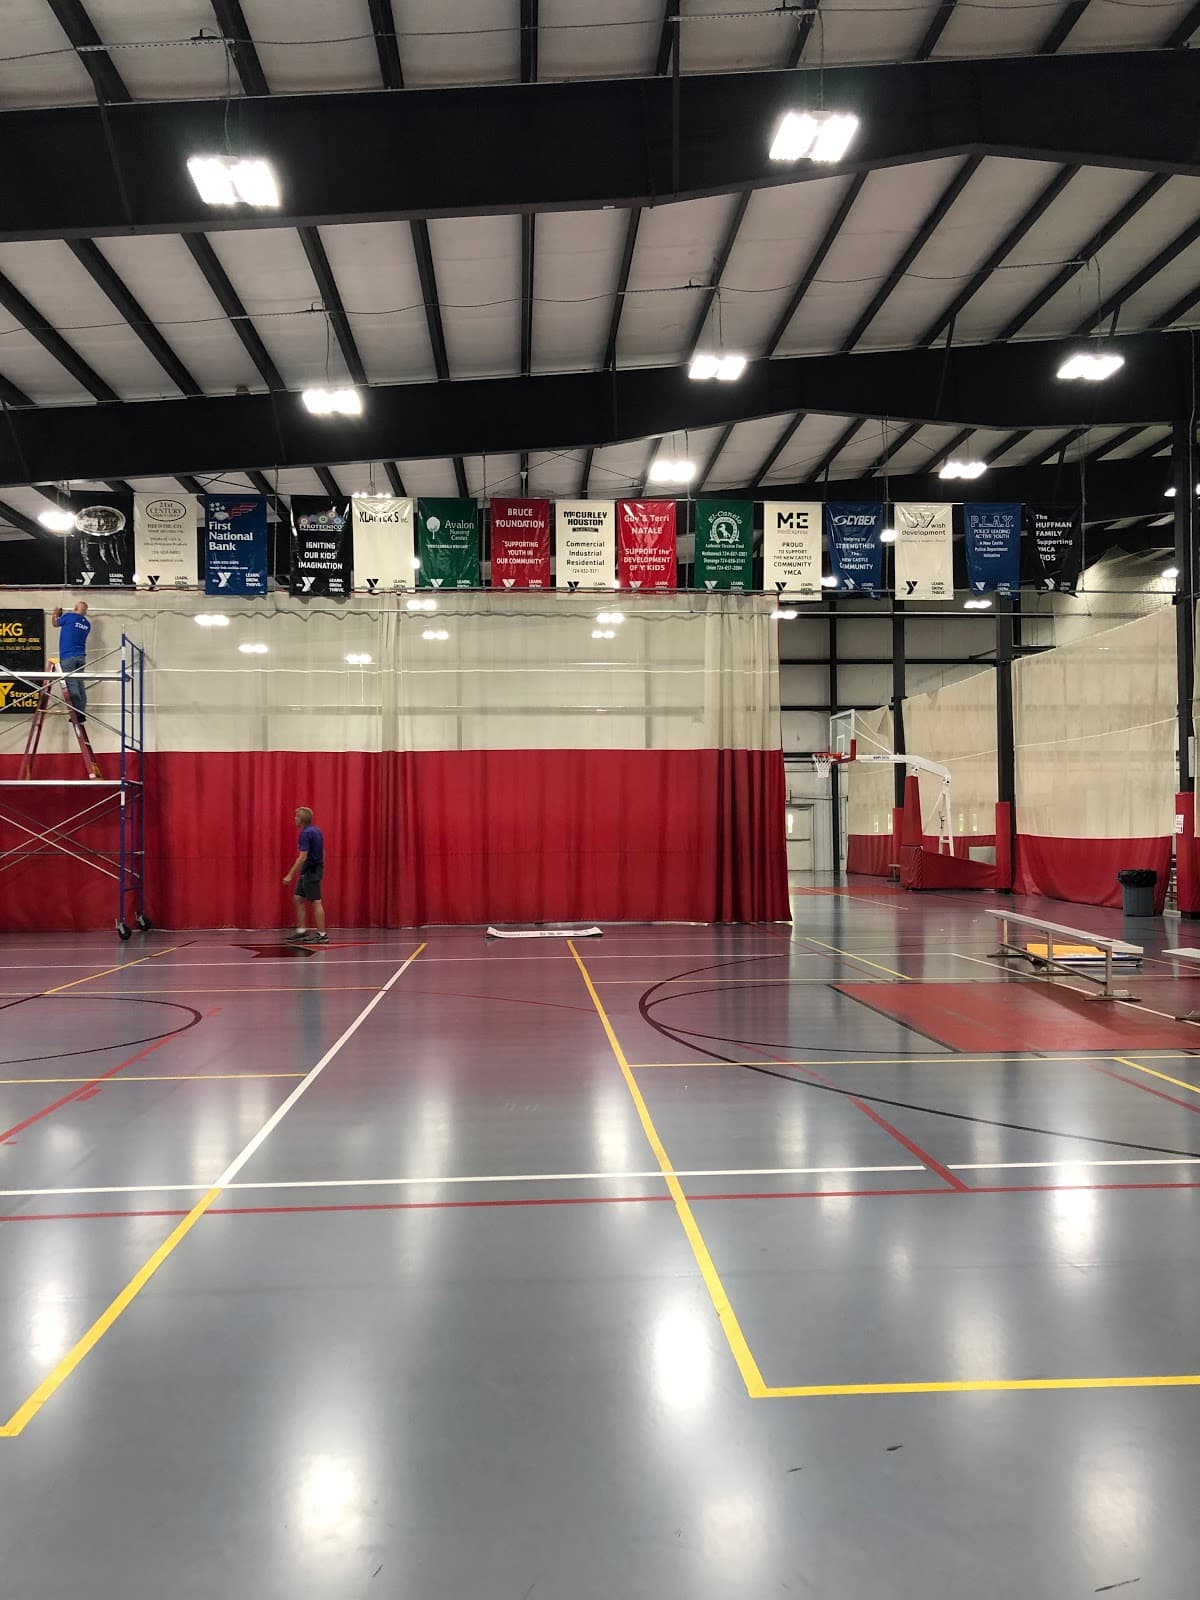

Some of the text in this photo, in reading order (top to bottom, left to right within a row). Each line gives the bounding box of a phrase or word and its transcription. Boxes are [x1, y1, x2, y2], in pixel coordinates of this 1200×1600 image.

[496, 520, 544, 528] FOUNDATION
[778, 512, 808, 528] ME
[846, 516, 876, 525] CYBEX
[208, 522, 231, 530] First
[444, 520, 474, 529] Avalon
[208, 532, 253, 540] National
[208, 542, 236, 550] Bank
[306, 542, 336, 550] IGNITING
[74, 622, 89, 630] STAFF
[10, 691, 40, 700] Strong
[12, 699, 38, 708] Kids
